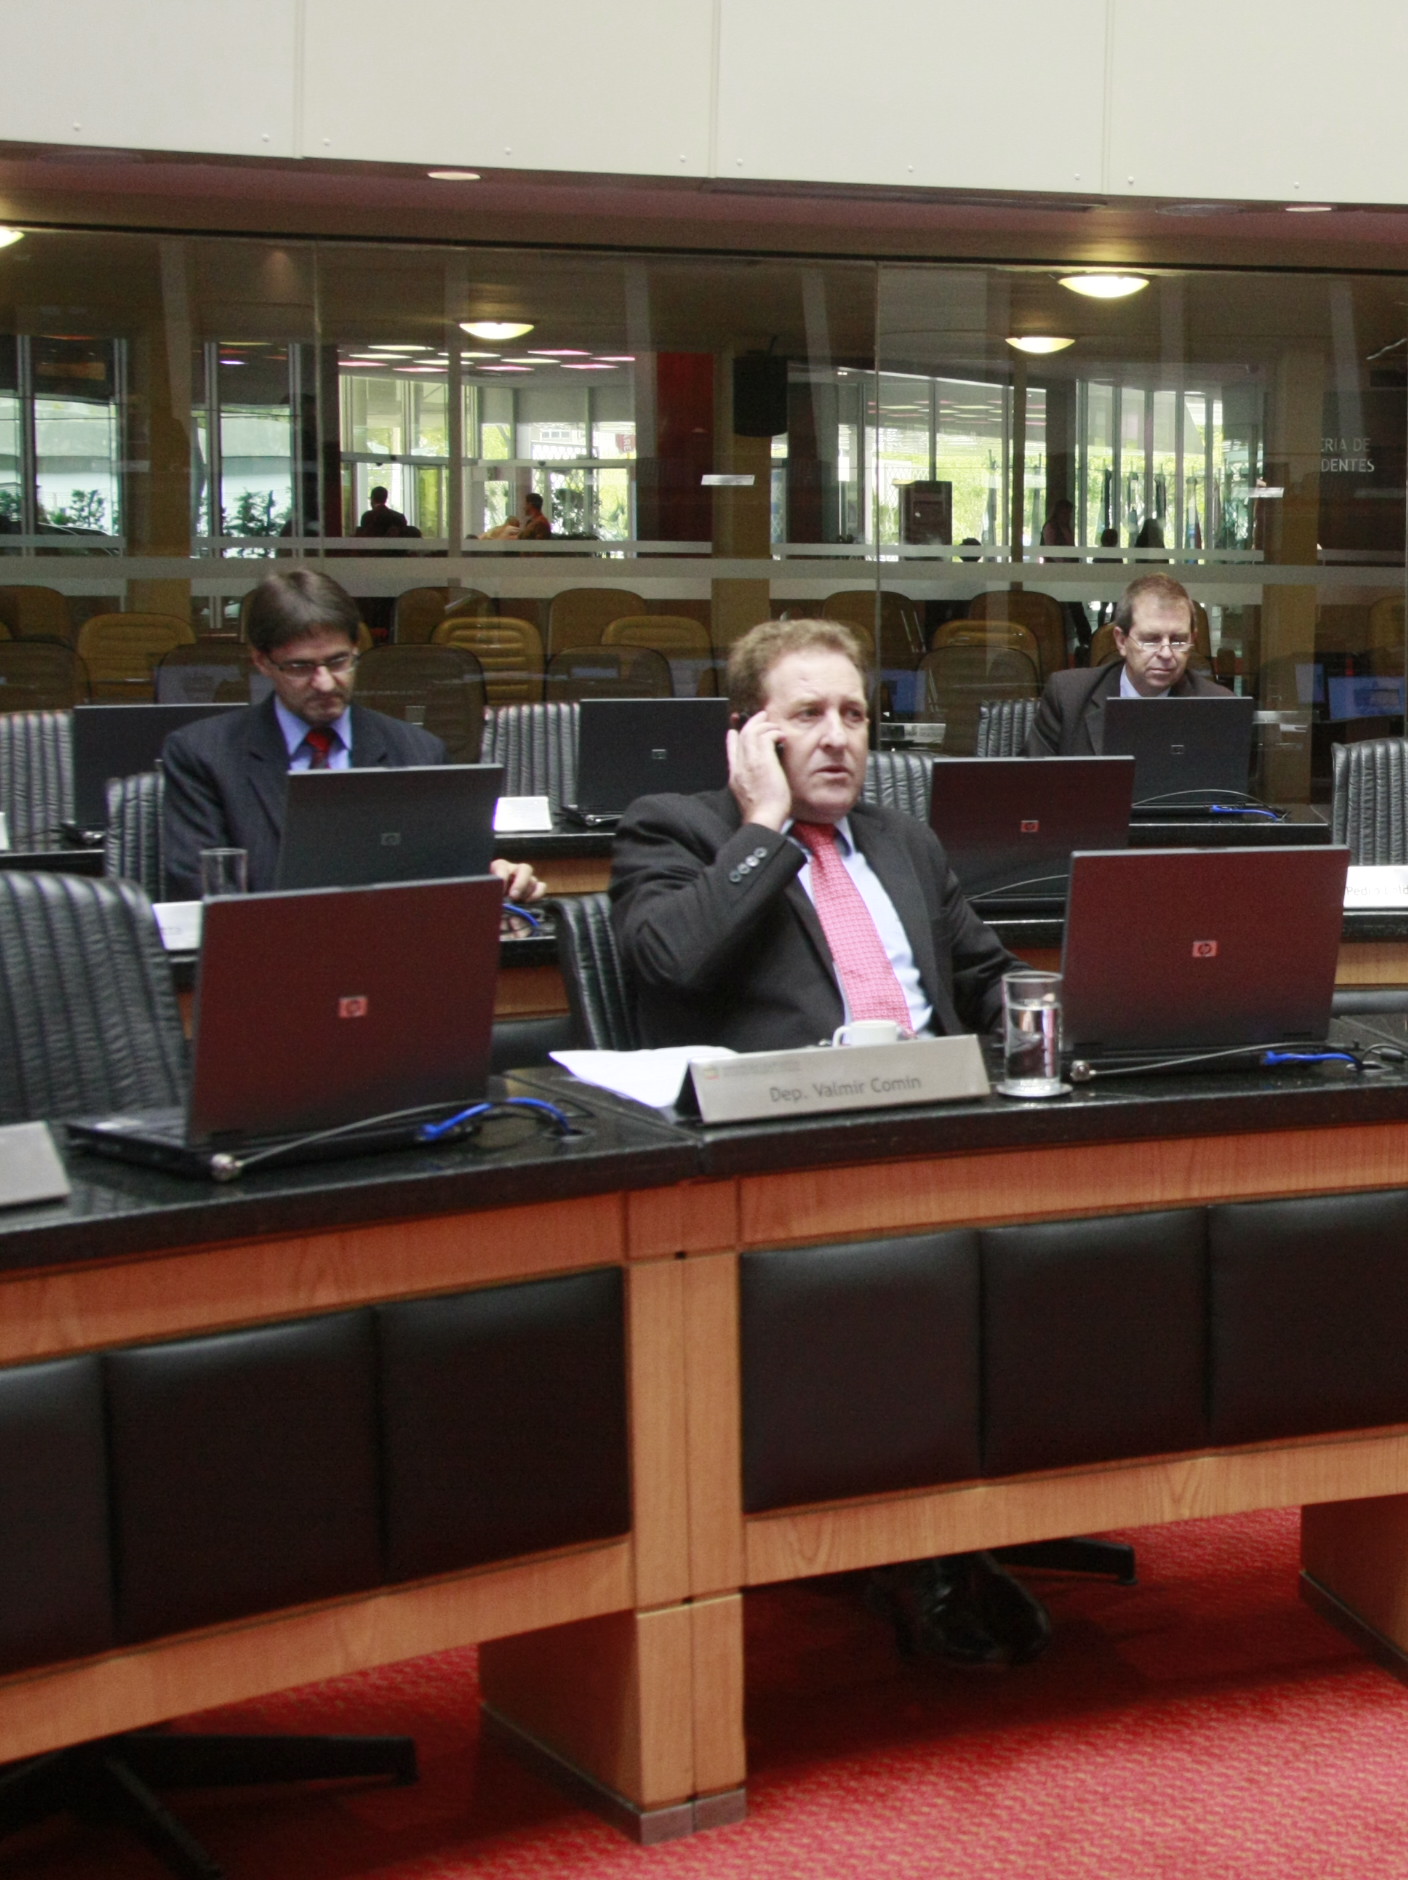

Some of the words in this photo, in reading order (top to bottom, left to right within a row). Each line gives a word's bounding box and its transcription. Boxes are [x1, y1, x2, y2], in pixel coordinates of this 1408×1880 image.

[1353, 437, 1371, 452] DE
[1320, 458, 1375, 473] DENTES
[769, 1086, 808, 1103] Dep.
[812, 1082, 865, 1099] Valmir
[870, 1075, 923, 1094] Comin
